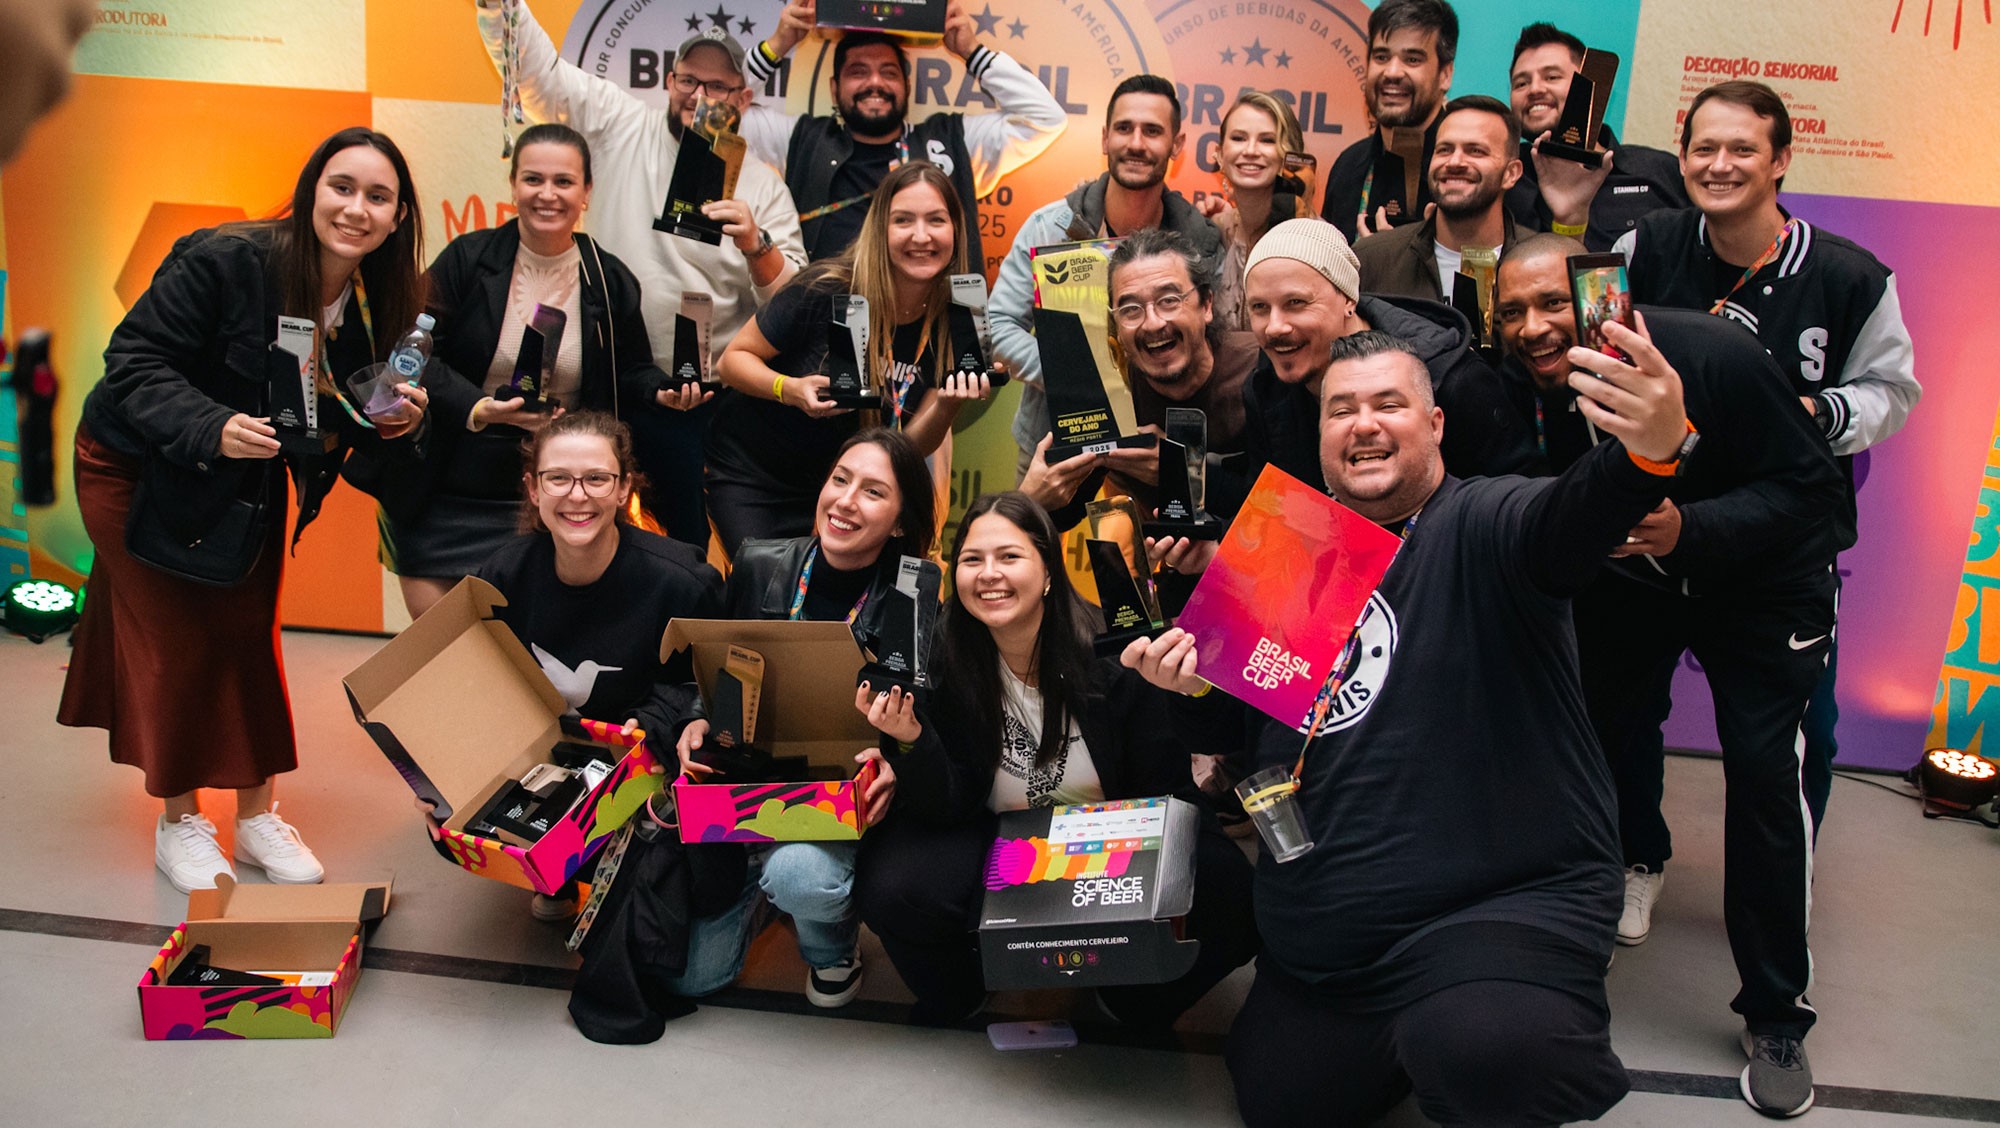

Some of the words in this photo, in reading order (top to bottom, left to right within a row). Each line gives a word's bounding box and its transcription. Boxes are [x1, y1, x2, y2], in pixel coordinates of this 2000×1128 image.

[94, 10, 168, 28] RODUTORA
[1208, 7, 1230, 22] DE
[1236, 2, 1308, 26] BEBIDAS
[1308, 18, 1330, 39] DA
[595, 51, 613, 79] IOR
[604, 0, 652, 49] CONCUR
[1071, 4, 1125, 80] AMÉRICA
[1683, 55, 1760, 78] DESCRIÇÃO
[1762, 61, 1839, 82] SENSORIAL
[1790, 117, 1826, 135] TORA
[1812, 136, 1847, 146] Atlântica
[1850, 139, 1860, 147] do
[1861, 139, 1887, 149] Brasil,
[1806, 147, 1816, 155] de
[1817, 148, 1847, 157] Janeiro
[1855, 150, 1872, 158] São
[1872, 150, 1896, 160] Paulo.
[978, 214, 1006, 238] 25
[1069, 255, 1100, 267] BRASIL
[1071, 264, 1093, 275] BEER
[1072, 272, 1091, 282] CUP
[1798, 326, 1828, 381] S
[1058, 412, 1108, 428] CERVEJARIA
[1069, 425, 1081, 434] DO
[1082, 422, 1099, 432] ANO
[1256, 636, 1312, 680] BRASIL
[1248, 650, 1294, 685] BEER
[1242, 665, 1279, 690] CUP
[1073, 876, 1143, 894] SCIENCE
[1071, 892, 1097, 907] OF
[1100, 889, 1144, 905] BEER
[1007, 941, 1035, 950] CONTÉM
[1035, 937, 1088, 948] CONHECIMENTO
[1088, 936, 1129, 946] CERVEJEIRO
